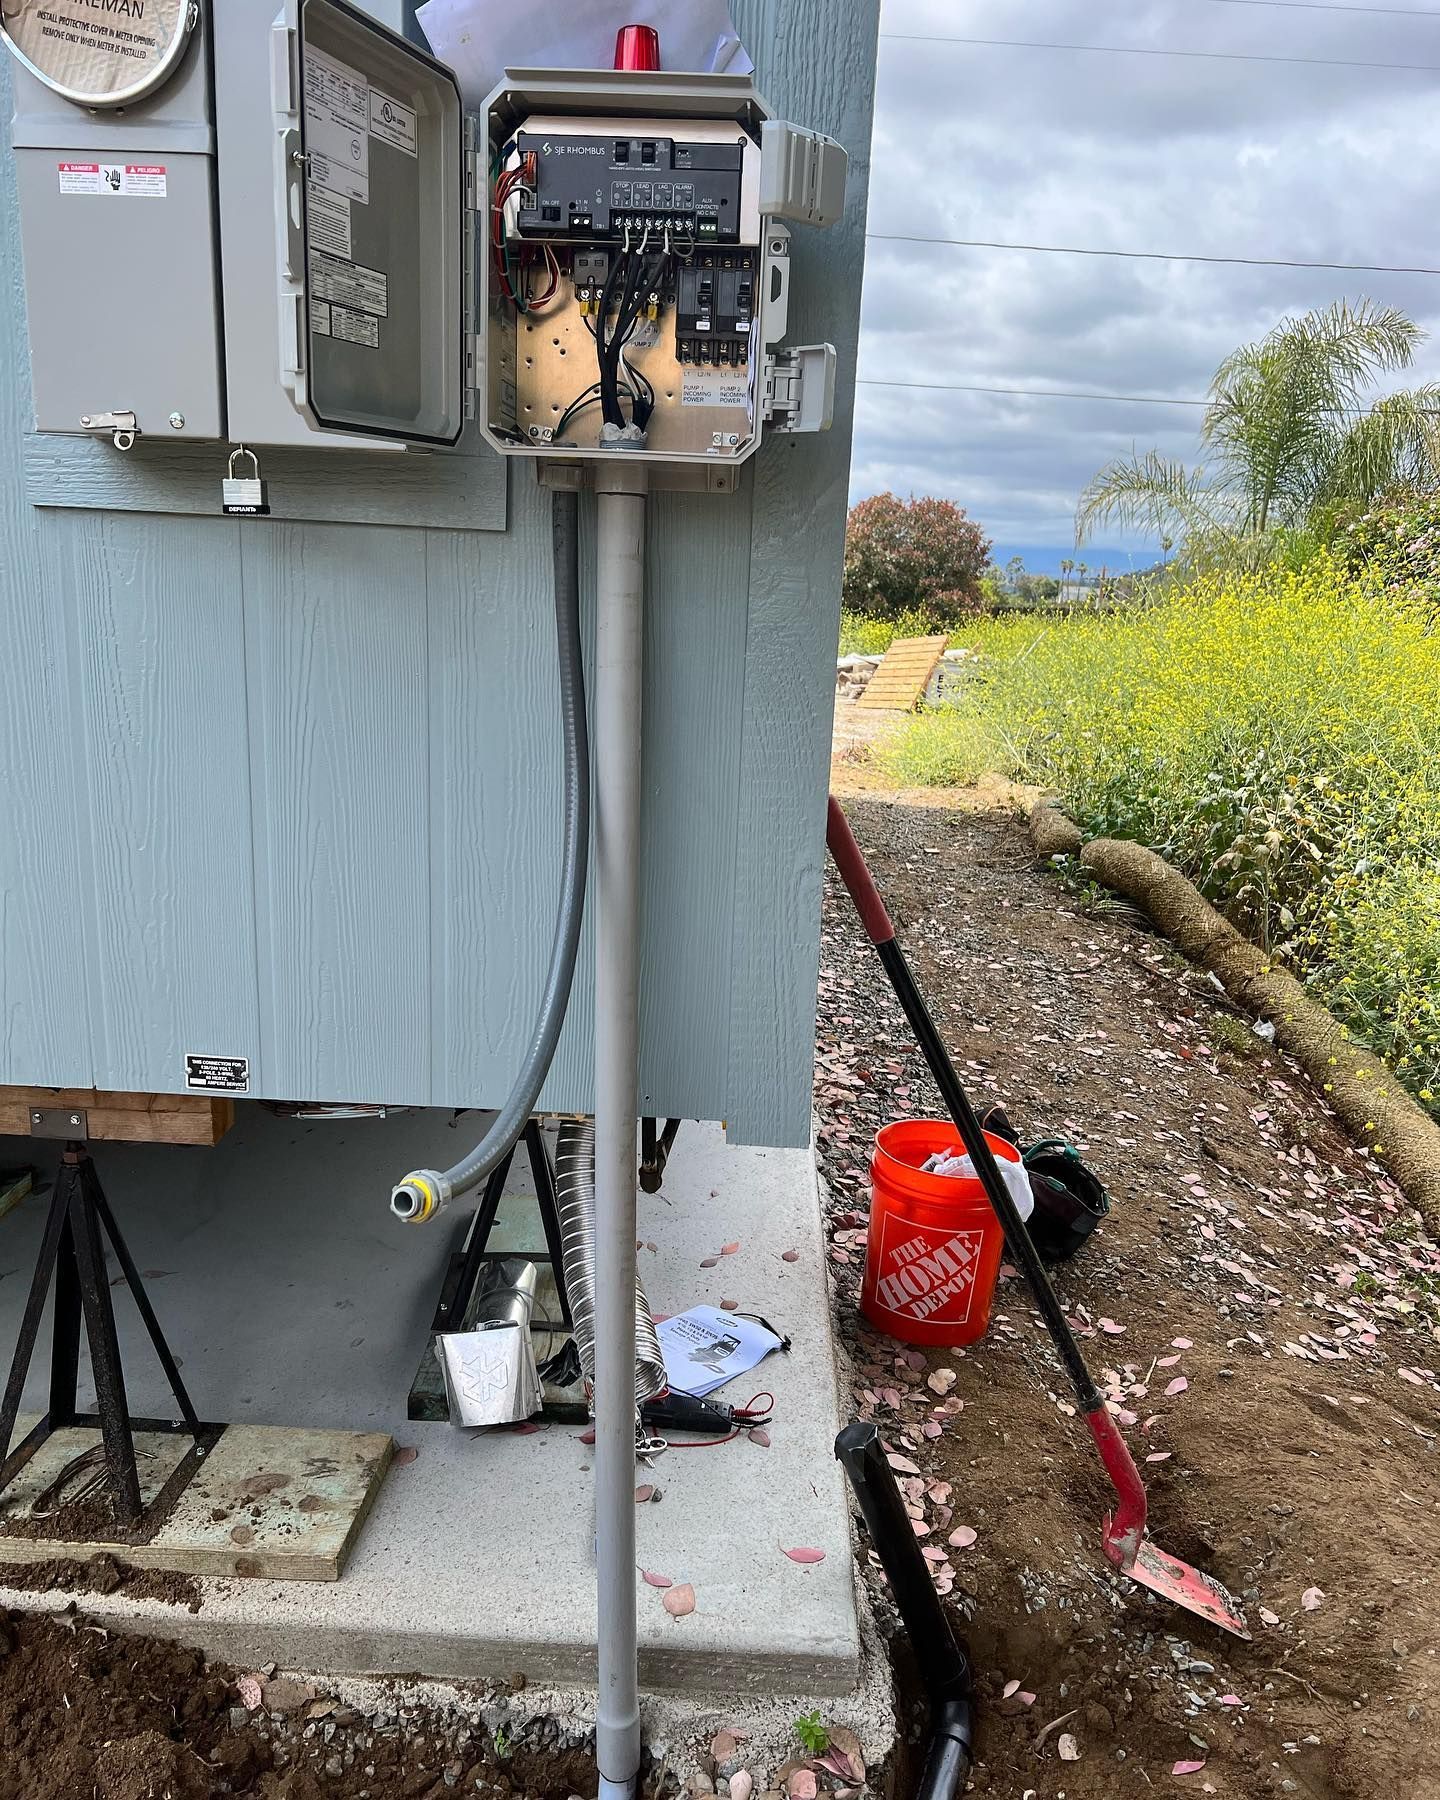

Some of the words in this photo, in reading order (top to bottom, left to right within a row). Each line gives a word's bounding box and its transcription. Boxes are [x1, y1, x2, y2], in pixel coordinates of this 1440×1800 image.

[37, 10, 58, 24] INSTALL
[58, 16, 90, 31] PROTECTIVE
[91, 24, 108, 36] COVER
[109, 28, 114, 38] IN
[115, 30, 133, 42] METER
[134, 34, 156, 46] OPENING
[42, 26, 65, 39] REMOVE
[66, 33, 80, 43] ONLY
[80, 36, 96, 48] WHEN
[97, 40, 114, 52] METER
[115, 45, 120, 53] IS
[121, 46, 146, 59] INSTALLED
[554, 146, 565, 155] SJE
[567, 146, 605, 155] RHOMBUS
[889, 1236, 932, 1266] THE
[879, 1232, 980, 1310] HOME
[909, 1265, 974, 1319] DEPOT
